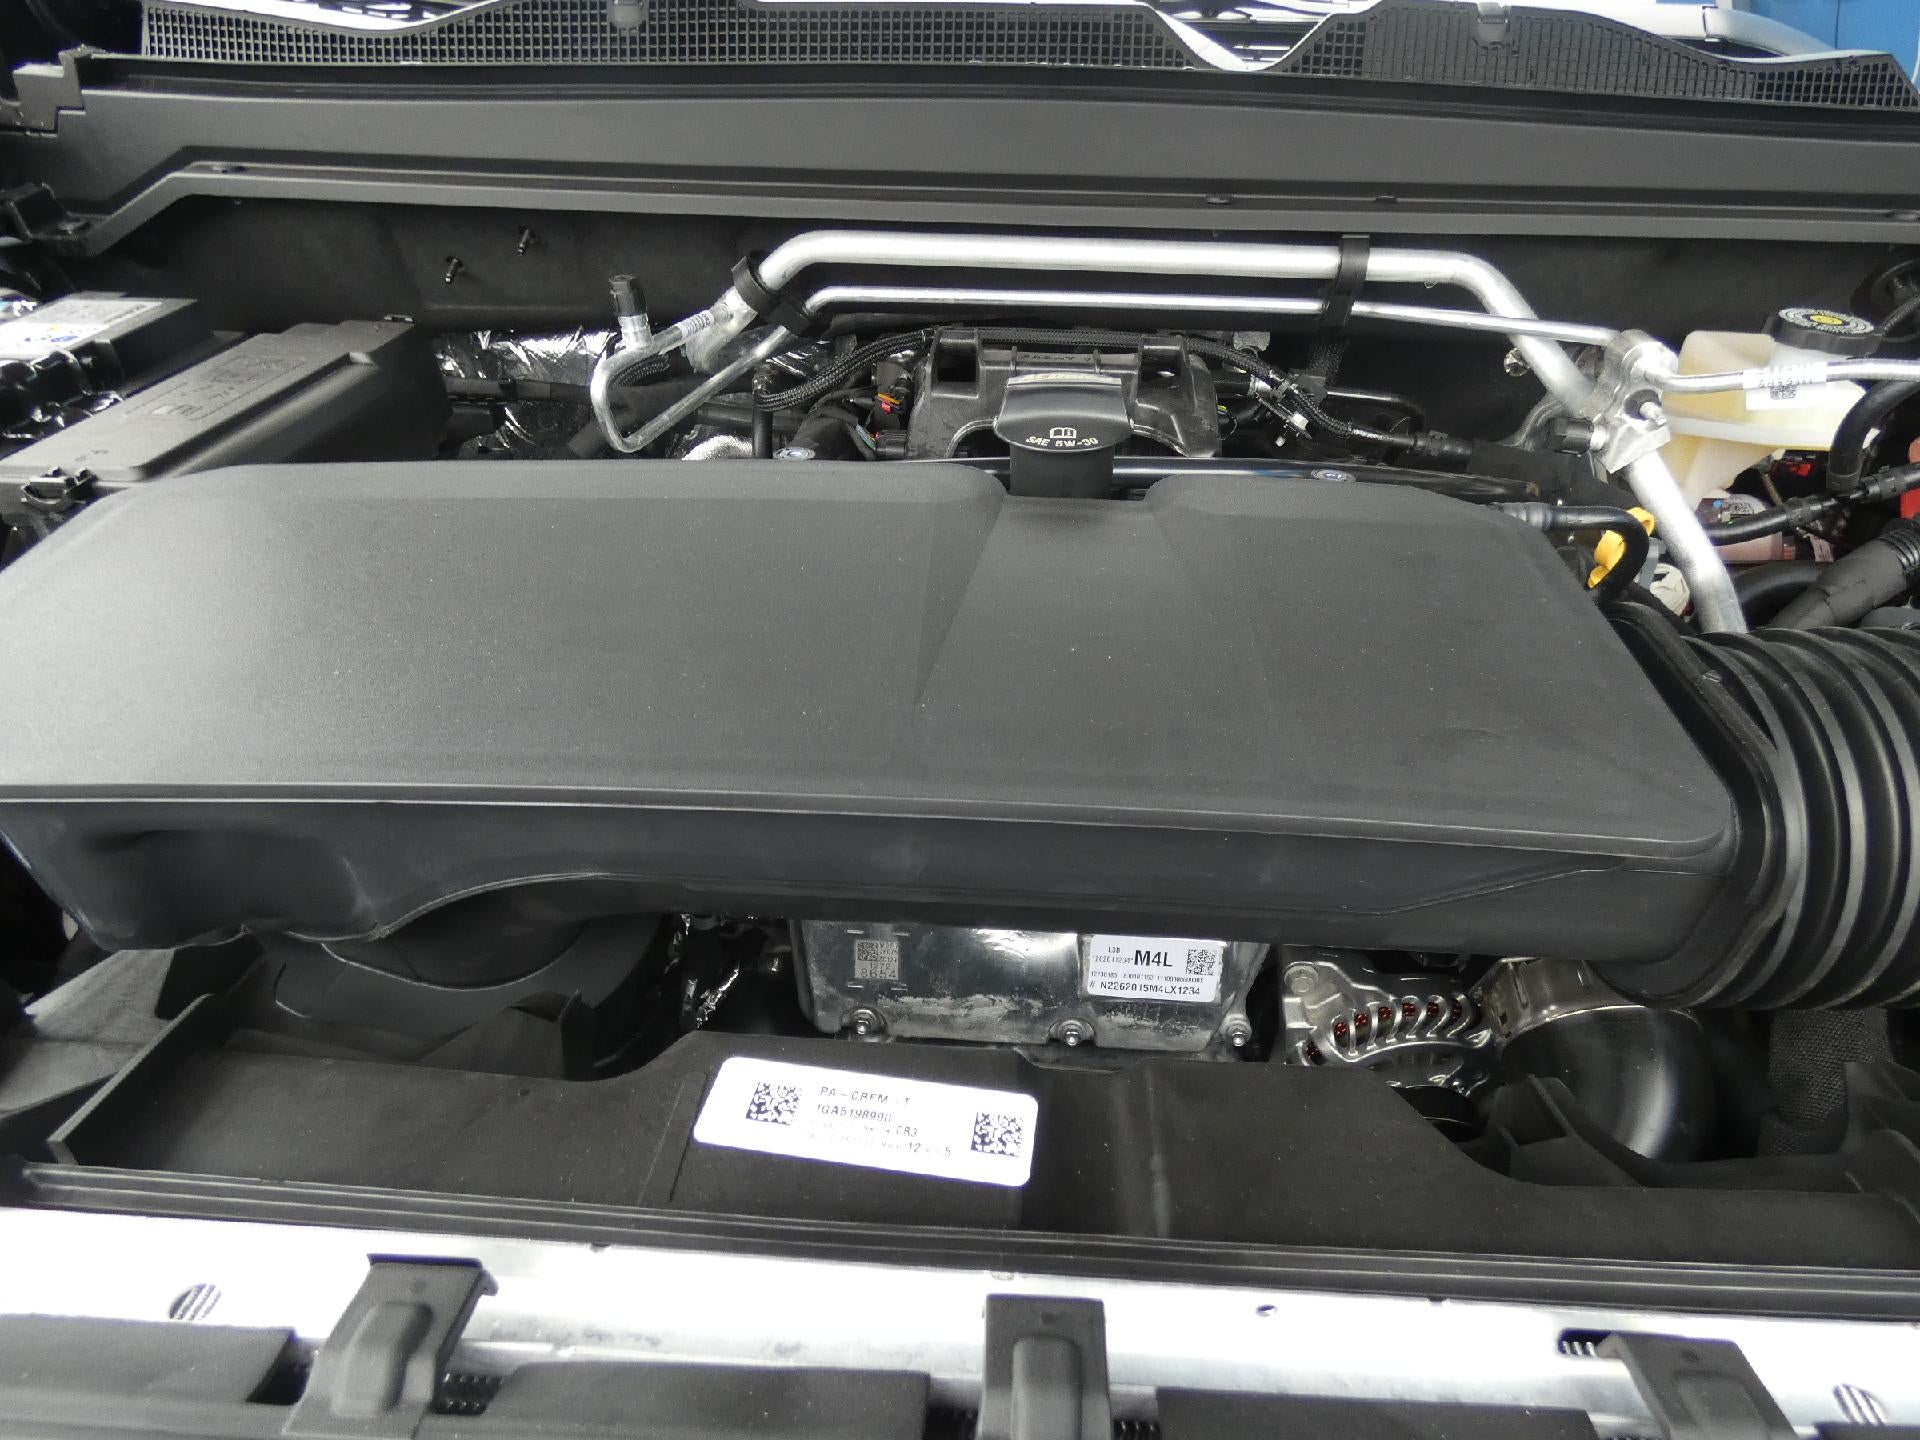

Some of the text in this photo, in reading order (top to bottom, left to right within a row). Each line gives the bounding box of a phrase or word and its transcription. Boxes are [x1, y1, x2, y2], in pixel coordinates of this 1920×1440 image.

[1025, 436, 1099, 447] SAE 5W-30
[1134, 949, 1173, 968] M4L
